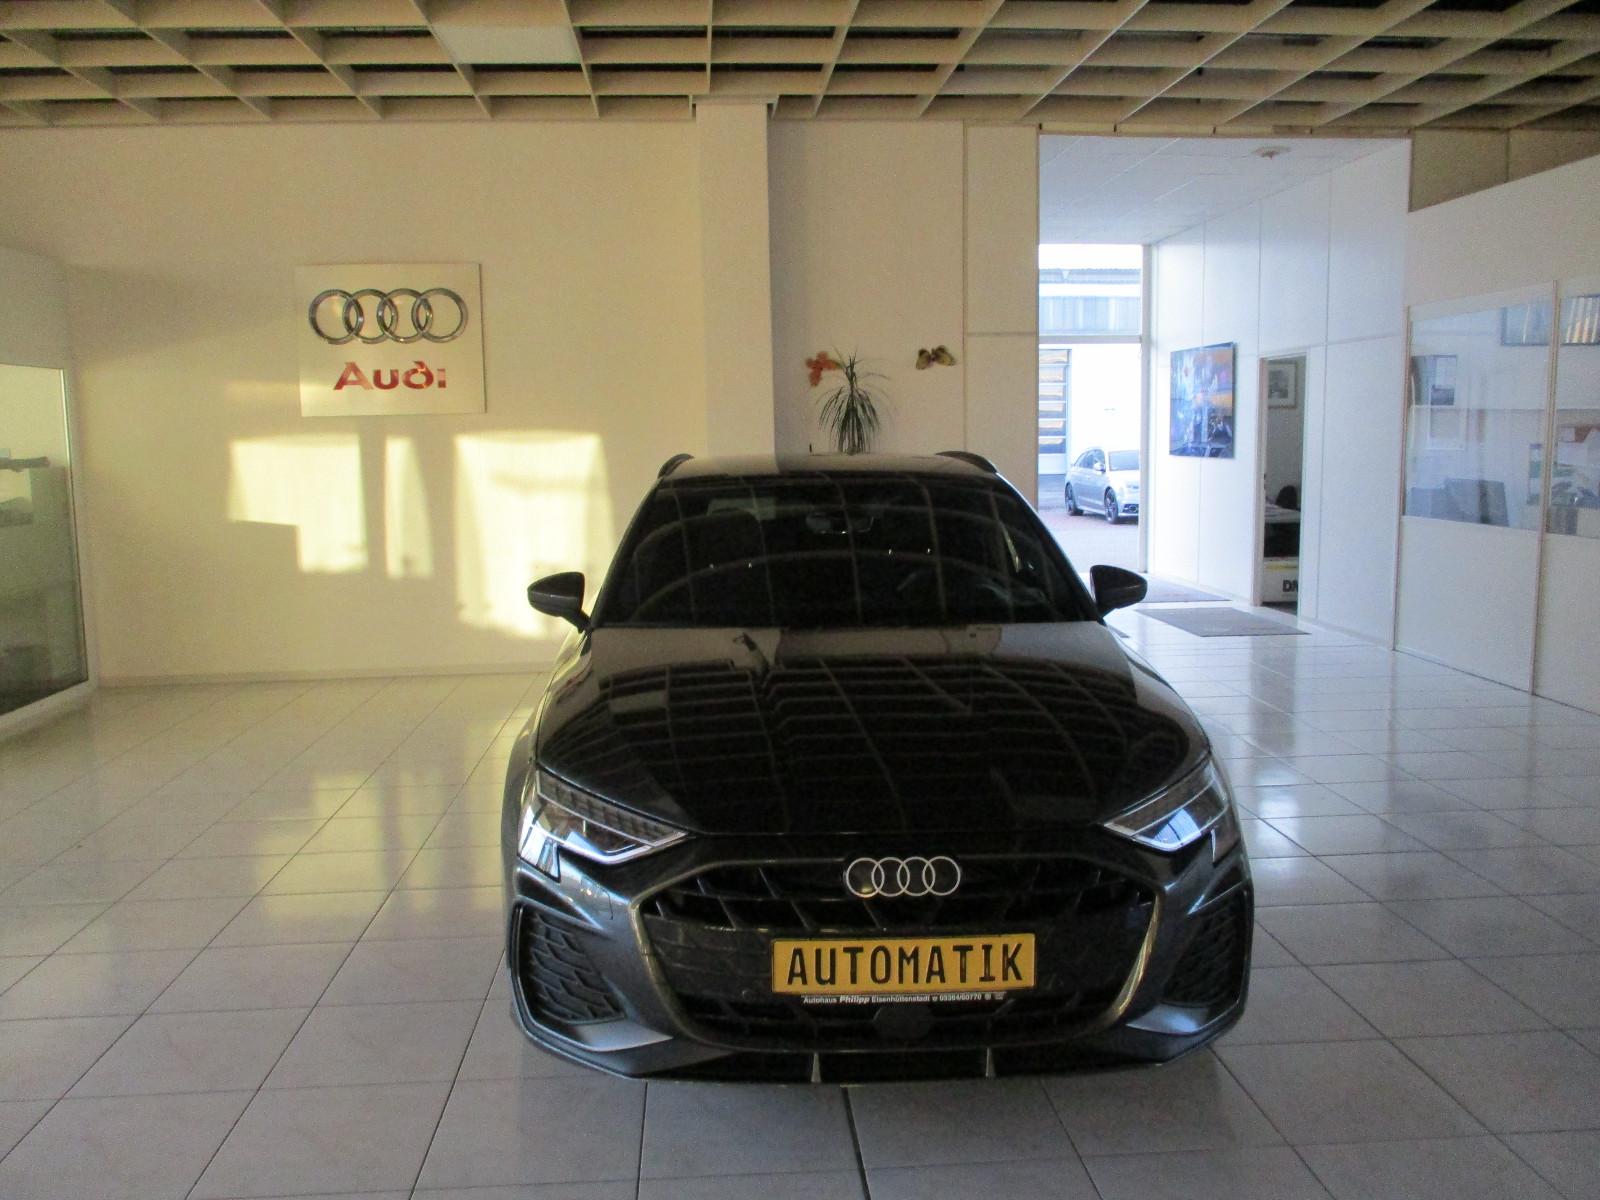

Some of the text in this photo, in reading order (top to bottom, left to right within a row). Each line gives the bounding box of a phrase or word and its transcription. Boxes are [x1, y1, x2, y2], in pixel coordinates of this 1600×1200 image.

[333, 361, 447, 390] Audi
[787, 943, 1023, 986] AUTOMATIK
[803, 995, 837, 1004] Autohaus
[839, 994, 871, 1004] Philipp
[871, 993, 931, 1003] Eisenhüttenstadt
